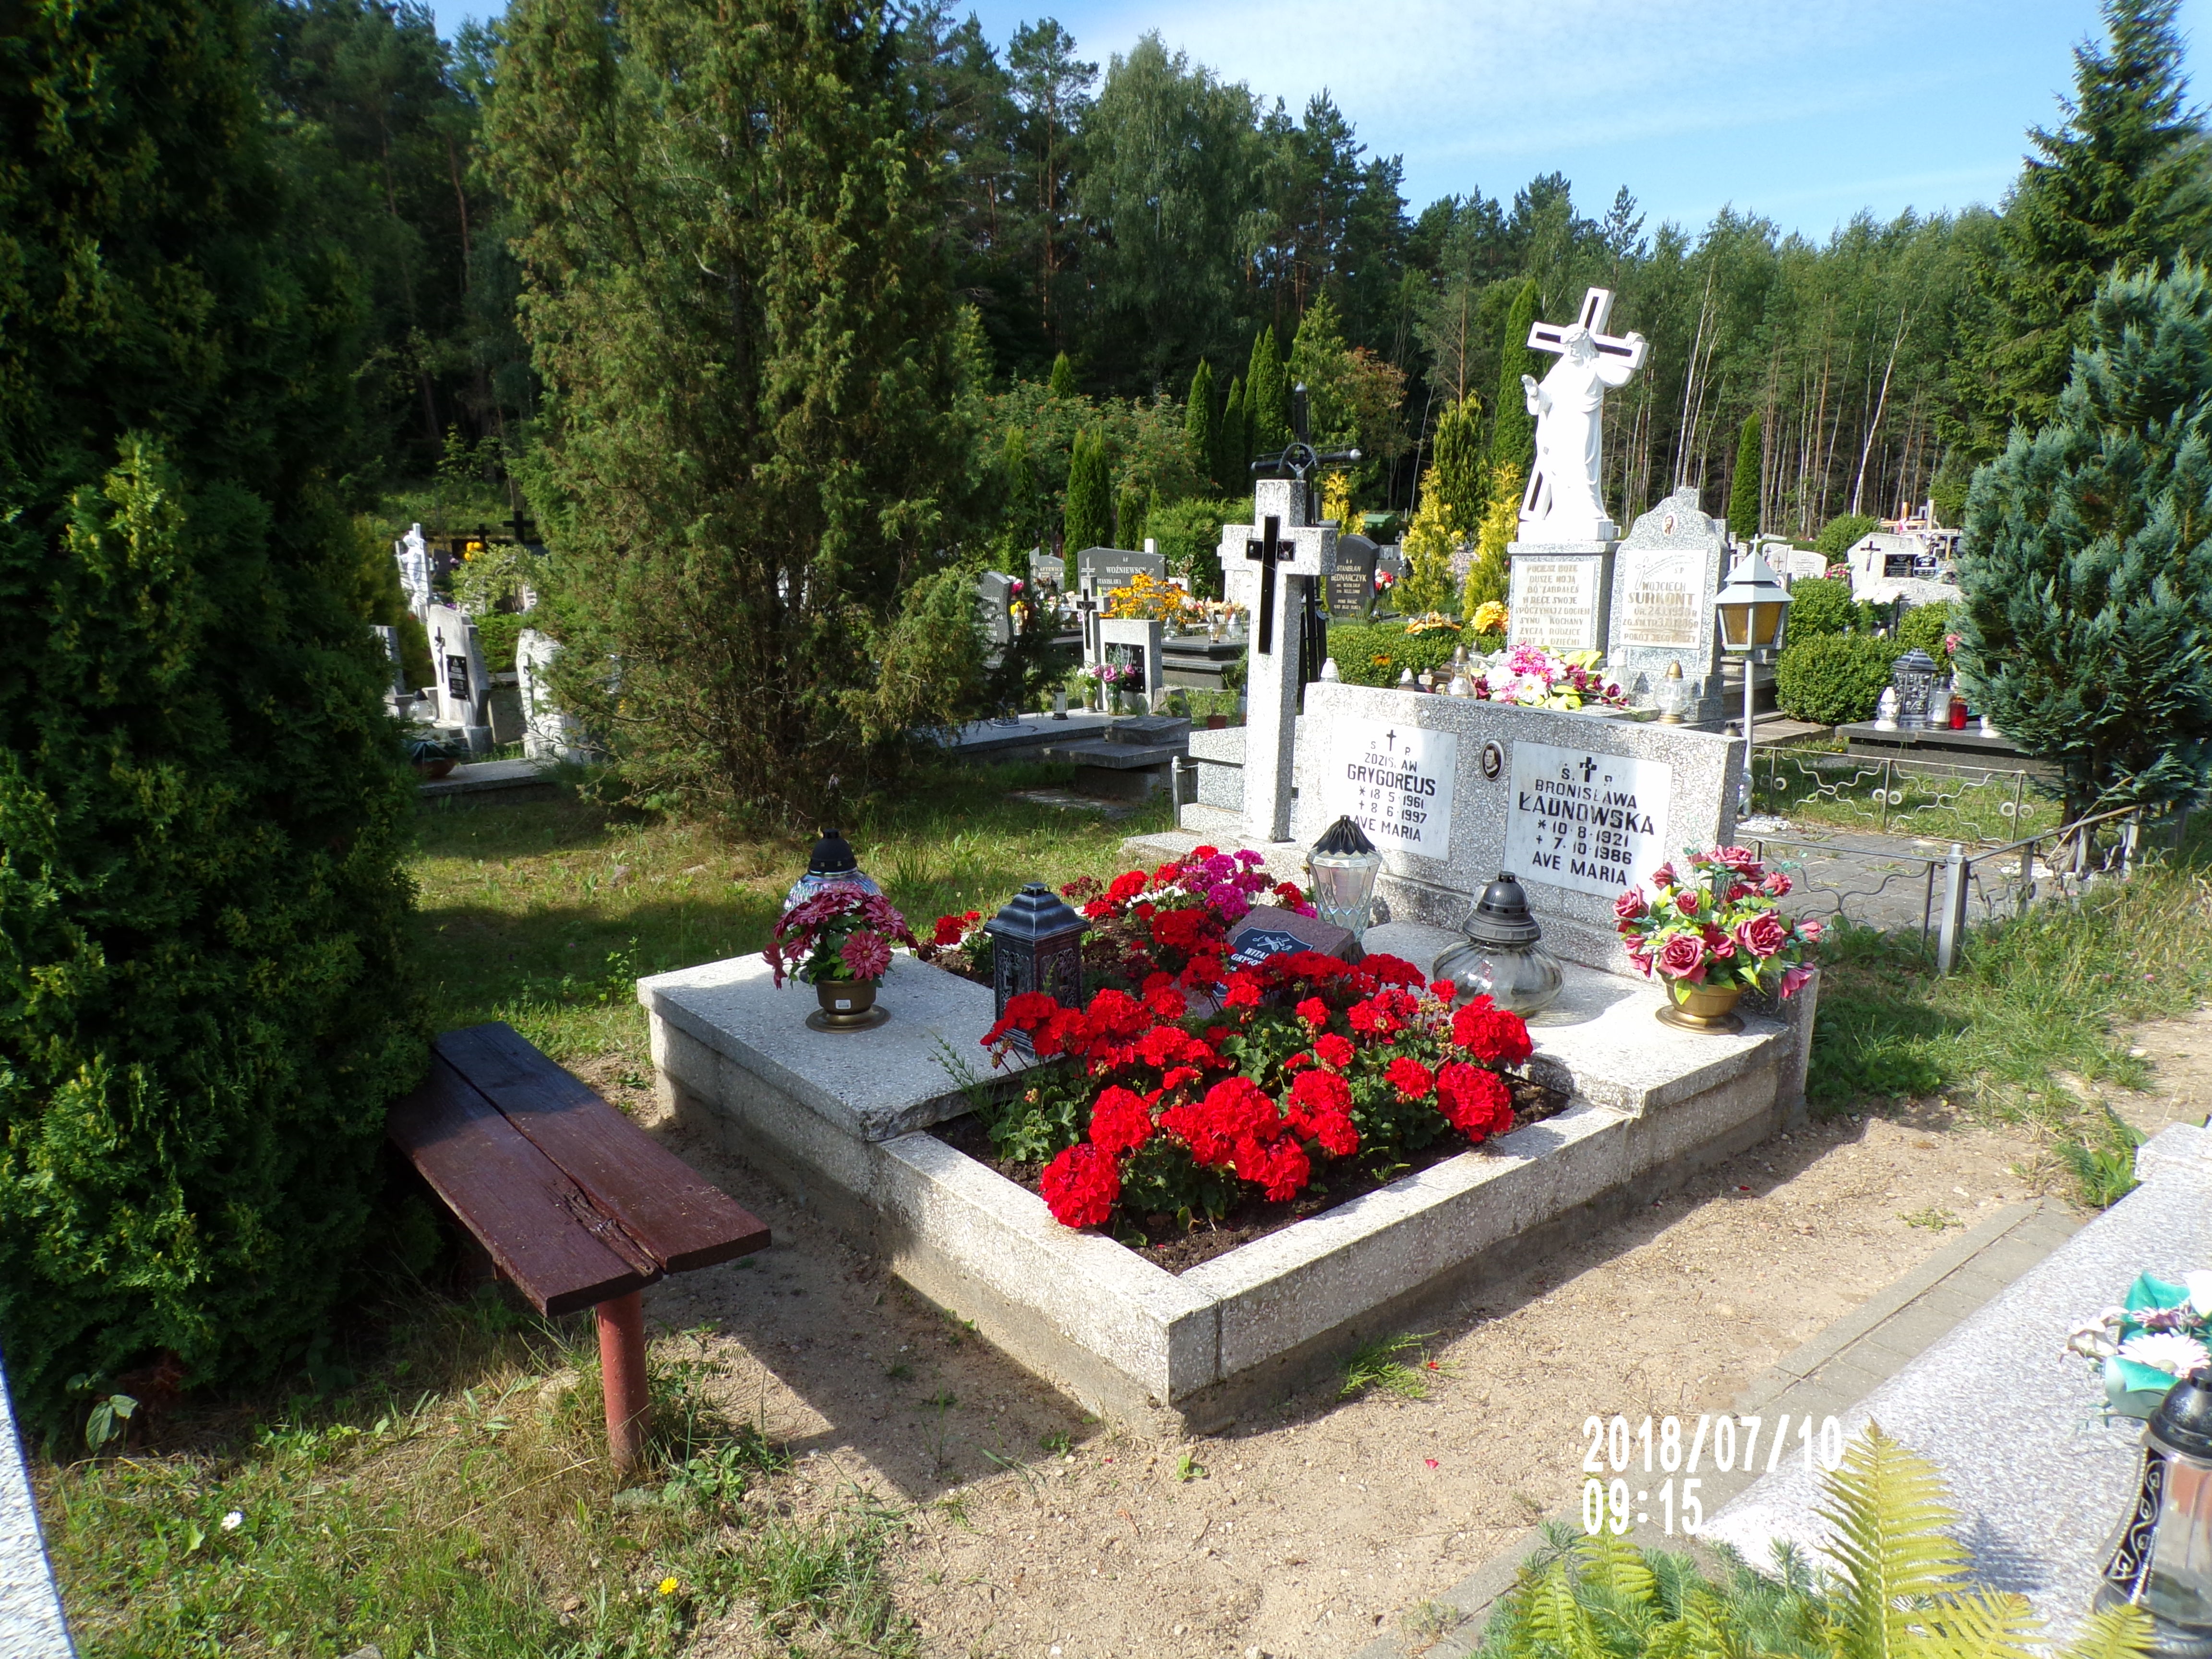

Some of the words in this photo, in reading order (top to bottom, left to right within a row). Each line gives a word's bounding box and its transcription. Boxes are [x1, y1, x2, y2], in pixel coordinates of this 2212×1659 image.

[1642, 581, 1685, 591] WOJCIECH
[1628, 592, 1695, 605] SURKONT
[1550, 617, 1583, 625] KOCHANY
[1365, 752, 1417, 772] ZDZISAW
[1347, 763, 1435, 796] GRYGOREUS
[1535, 779, 1637, 809] BRONISŁAWA
[1518, 791, 1654, 835] ŁADNOWSKA
[1381, 820, 1421, 842] MARIA
[1532, 851, 1561, 870] AVE
[1570, 859, 1627, 886] MARIA
